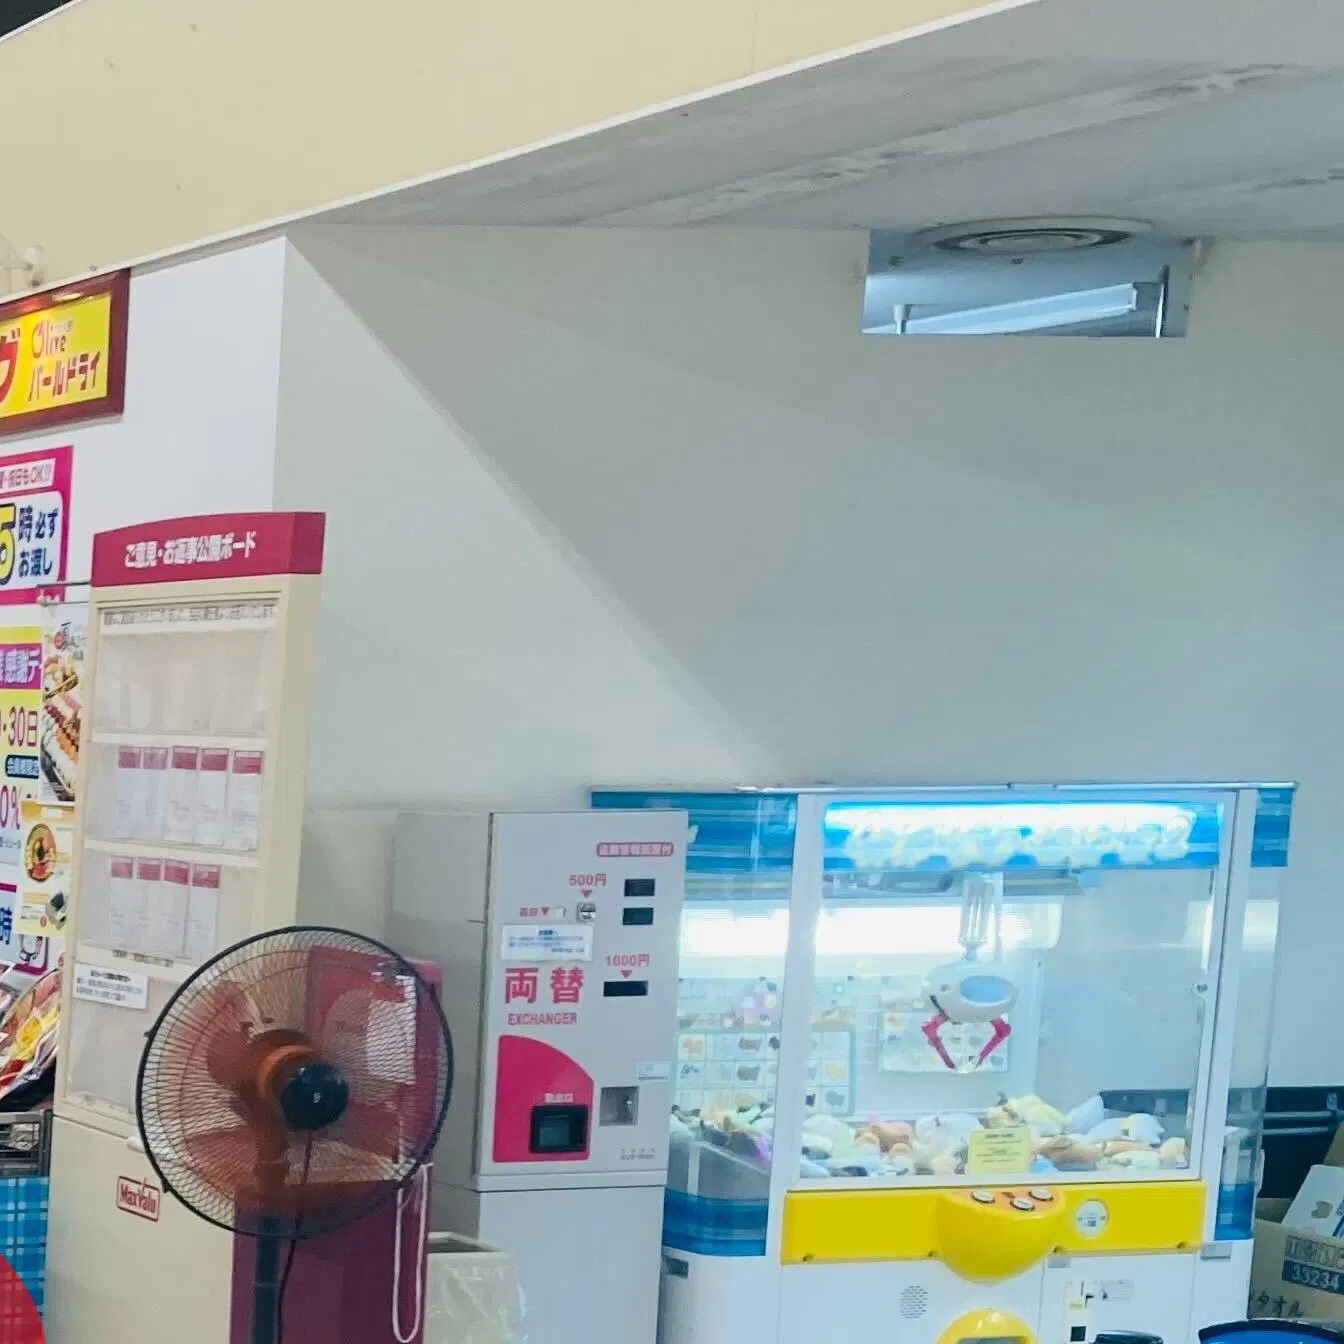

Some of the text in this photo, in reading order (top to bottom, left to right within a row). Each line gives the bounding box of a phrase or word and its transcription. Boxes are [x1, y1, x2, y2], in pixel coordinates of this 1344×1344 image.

[32, 319, 67, 358] Olive
[29, 351, 101, 402] パールドライ
[569, 872, 607, 887] 500円
[606, 953, 650, 968] 1000円
[504, 966, 585, 1004] 両替
[507, 1012, 578, 1026] EXCHANGER
[120, 1177, 157, 1215] MaxValu
